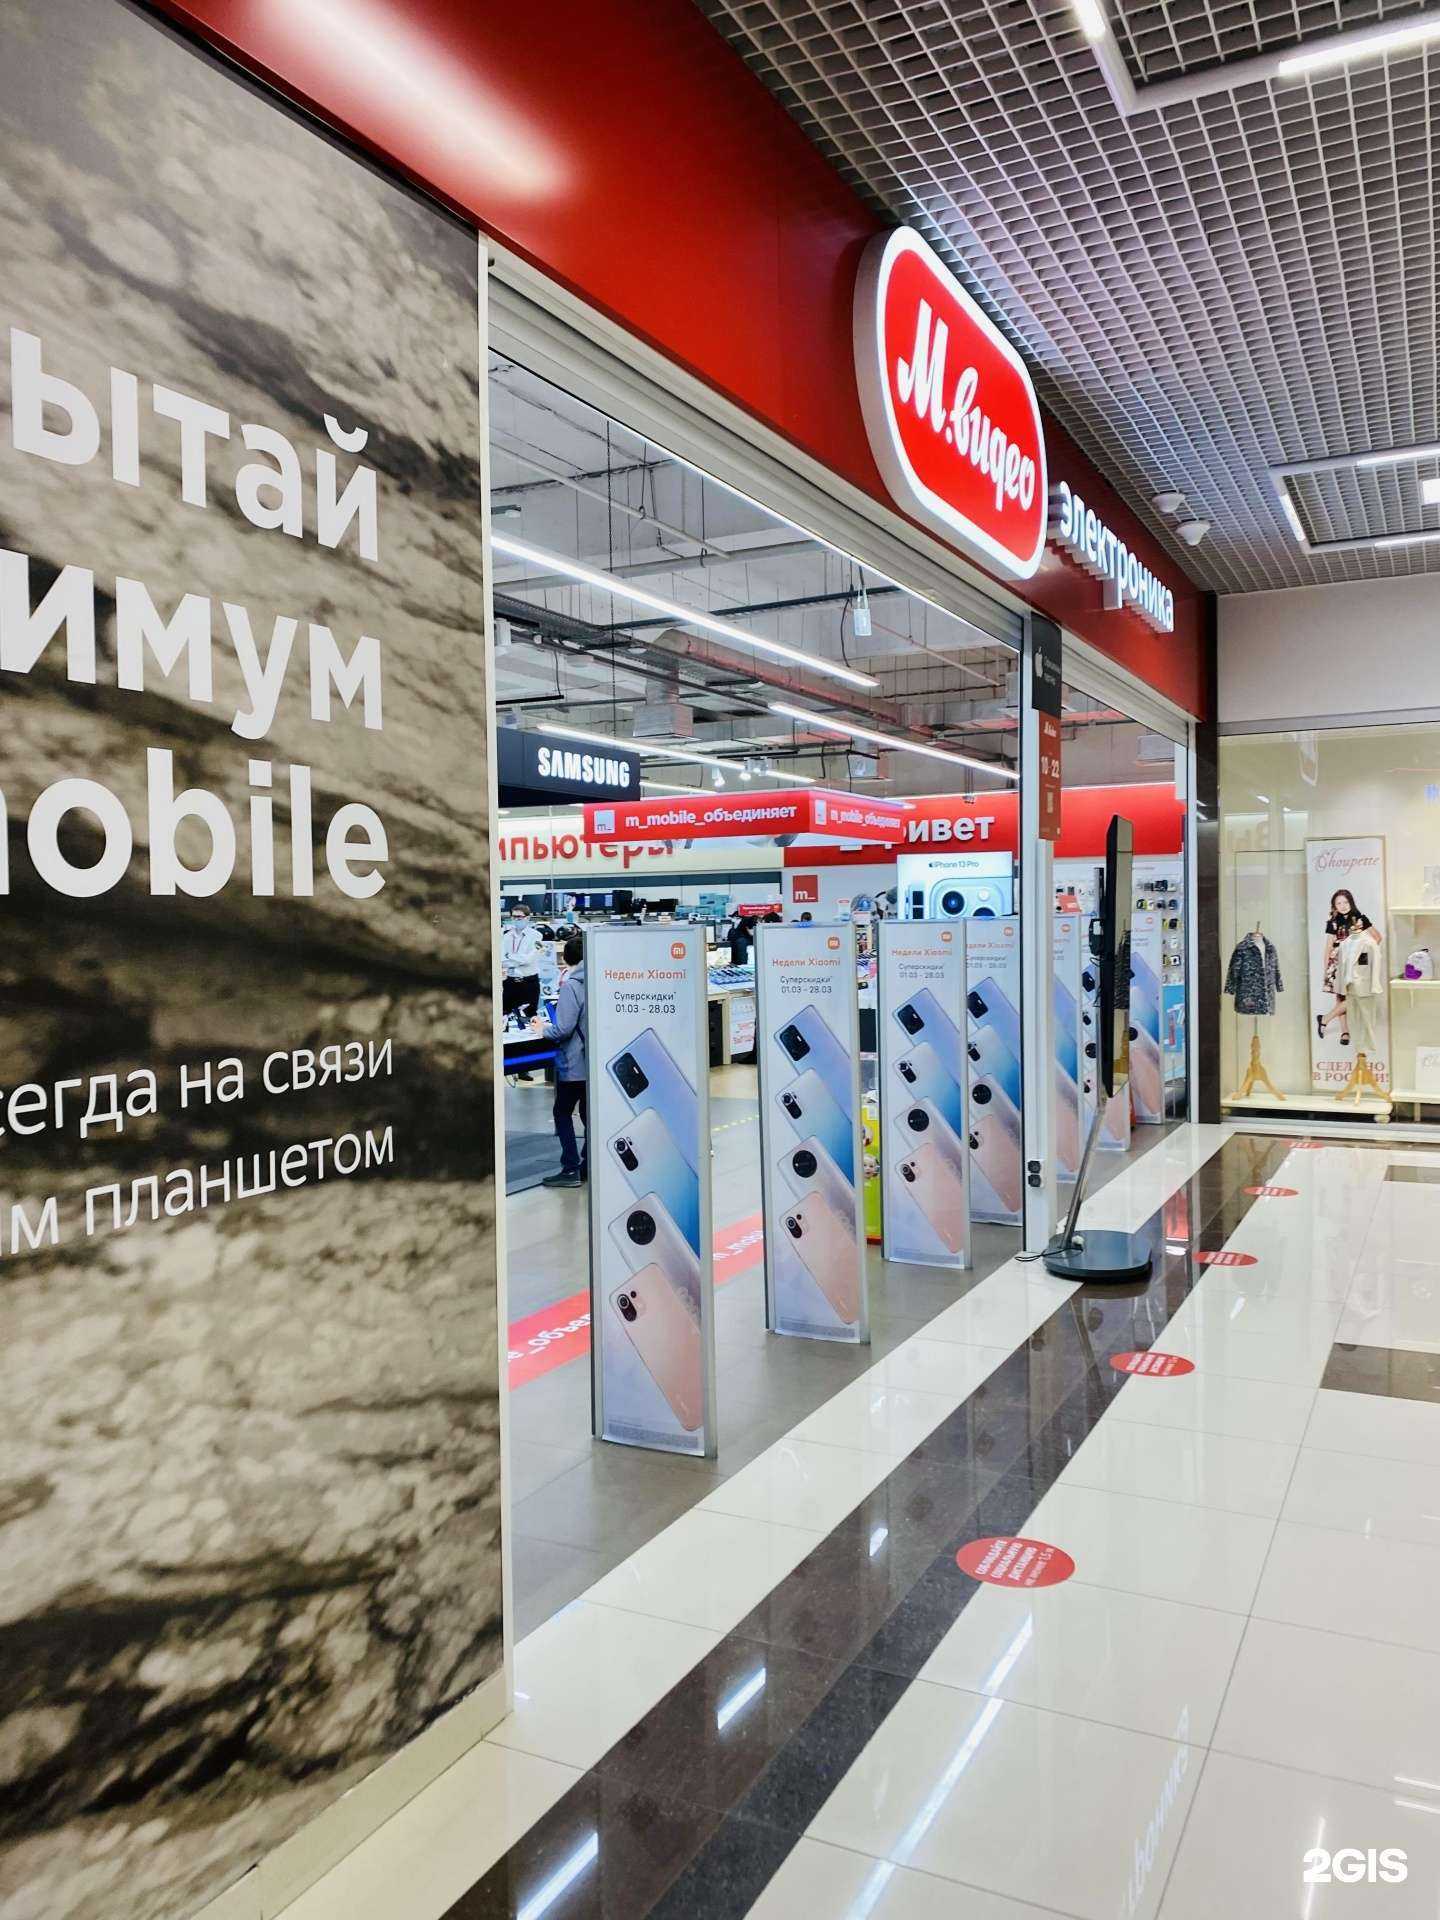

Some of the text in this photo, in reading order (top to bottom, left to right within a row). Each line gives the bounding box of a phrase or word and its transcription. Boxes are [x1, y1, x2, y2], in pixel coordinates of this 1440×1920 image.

[538, 747, 630, 788] SAMSUNG
[0, 747, 389, 899] obile
[625, 805, 796, 828] m_mobile_объединяет
[903, 815, 995, 843] ивет
[808, 957, 841, 966] Xiaomi
[604, 969, 687, 981] Недели Xiaomi
[615, 1004, 640, 1014] 01.03
[648, 1004, 677, 1014] 28.03
[1316, 1061, 1385, 1072] СДЕЛНО
[0, 1038, 393, 1139] егда на связи
[85, 1125, 395, 1237] планшетом
